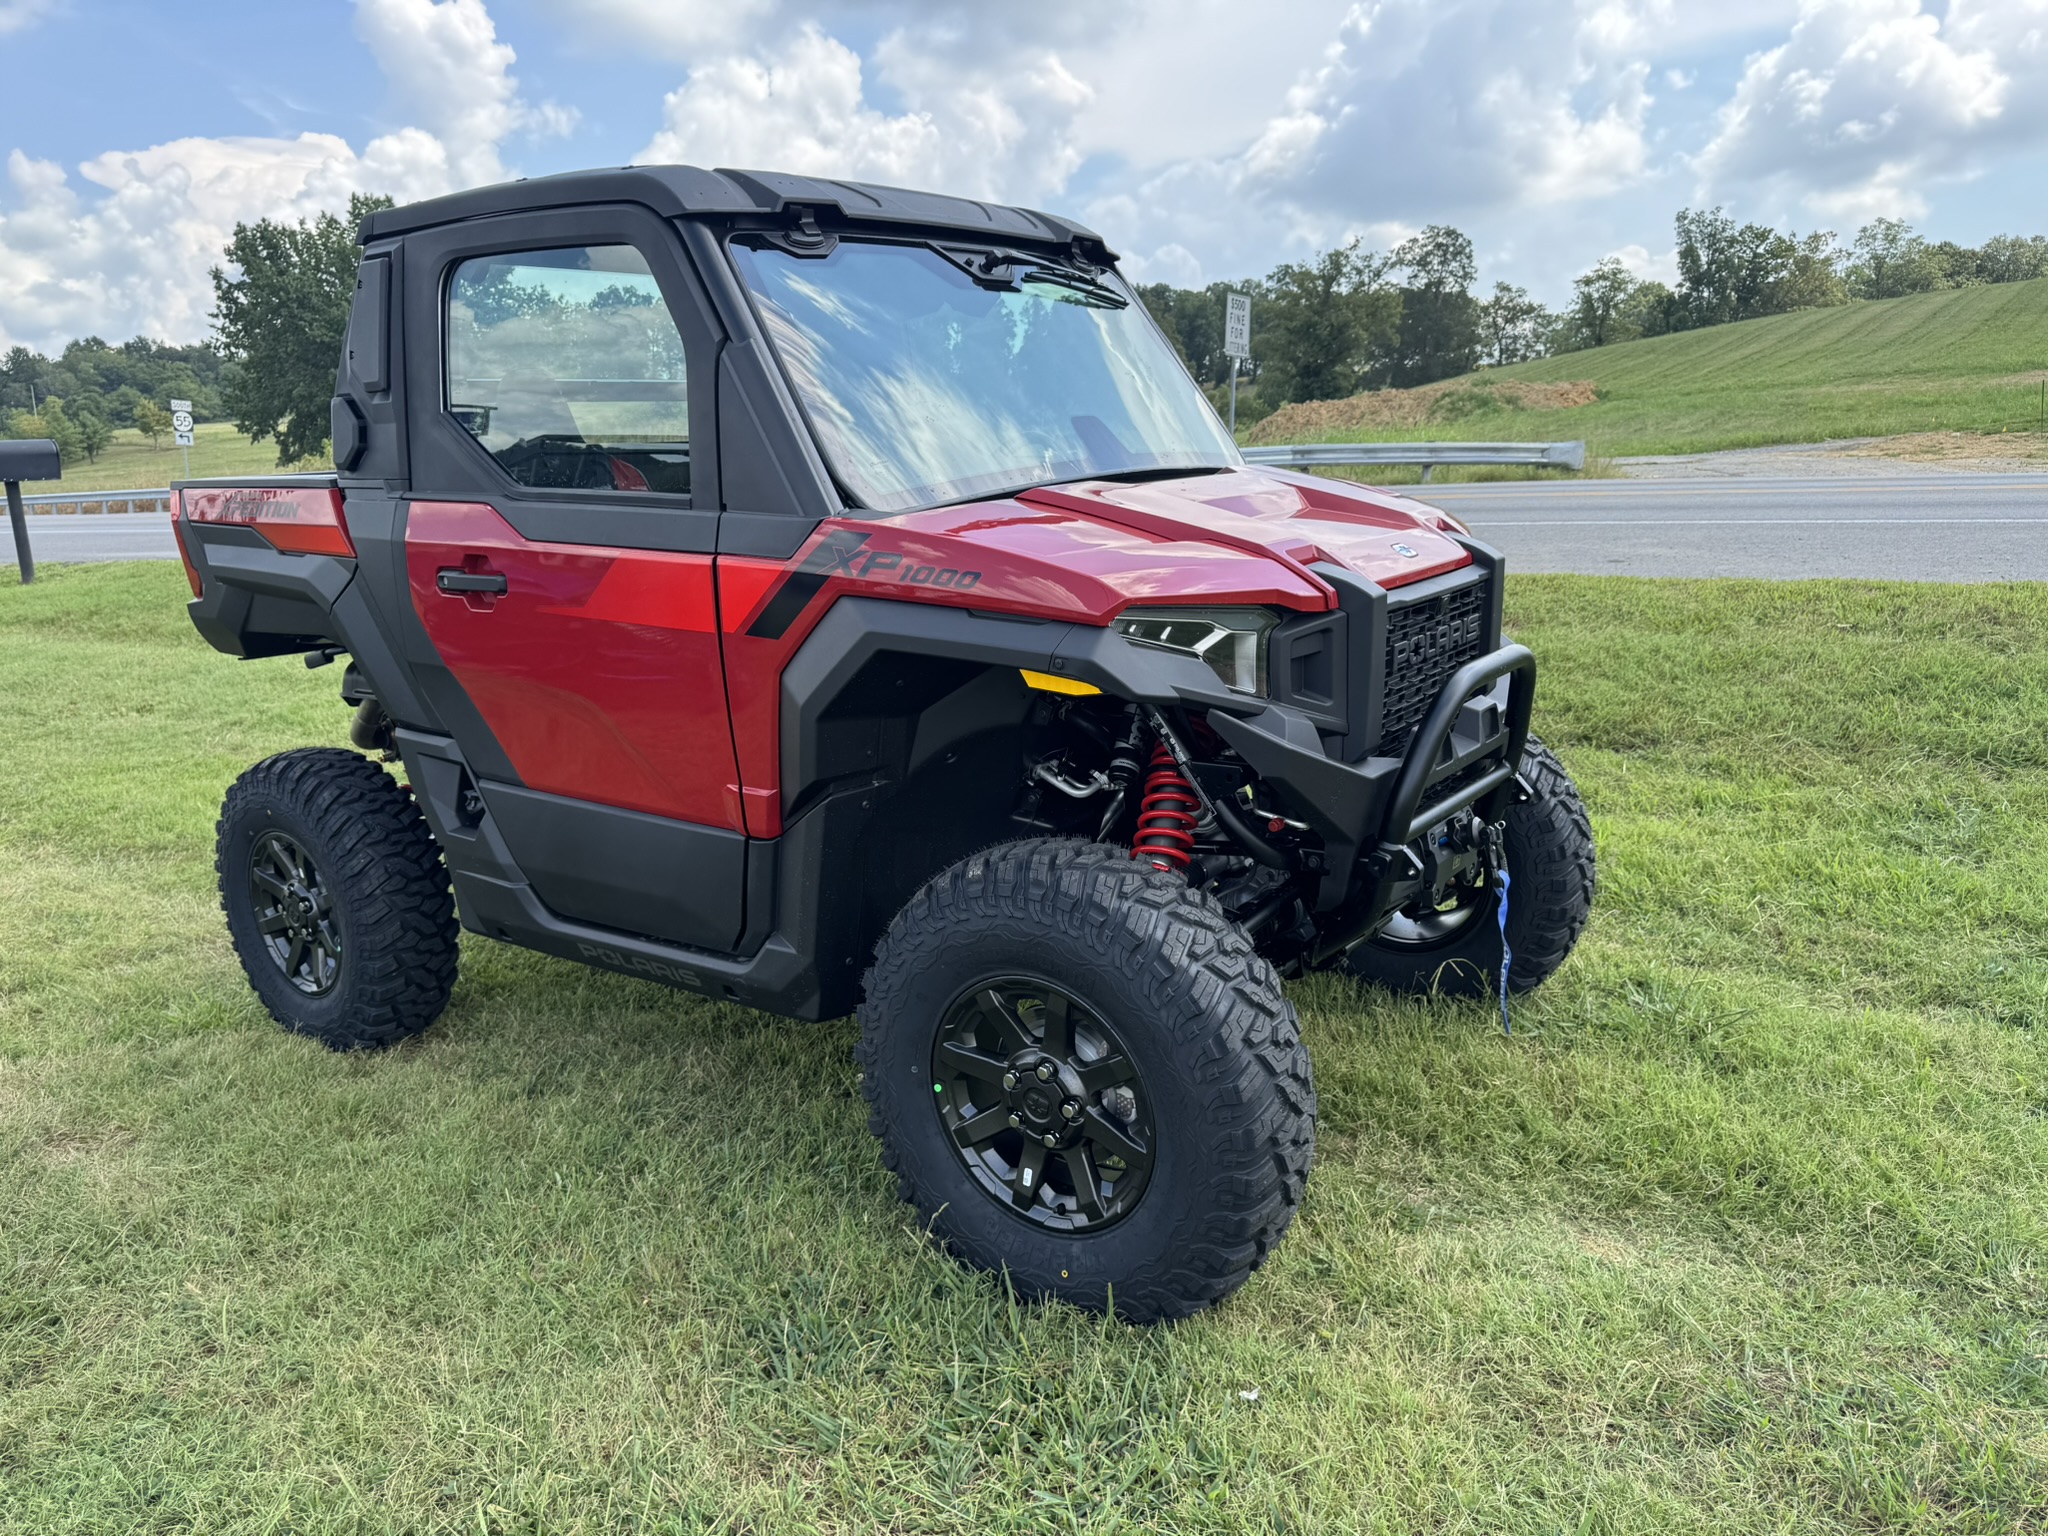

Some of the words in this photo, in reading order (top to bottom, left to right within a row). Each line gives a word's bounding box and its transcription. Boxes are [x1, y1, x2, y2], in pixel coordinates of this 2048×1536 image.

[1231, 297, 1246, 311] $500
[1229, 312, 1245, 326] FINE
[1230, 326, 1243, 339] FOR
[176, 416, 191, 427] 55
[816, 545, 903, 578] XP
[900, 564, 983, 590] 1000
[1393, 613, 1481, 672] POLARIS
[577, 943, 702, 987] POLARIS
